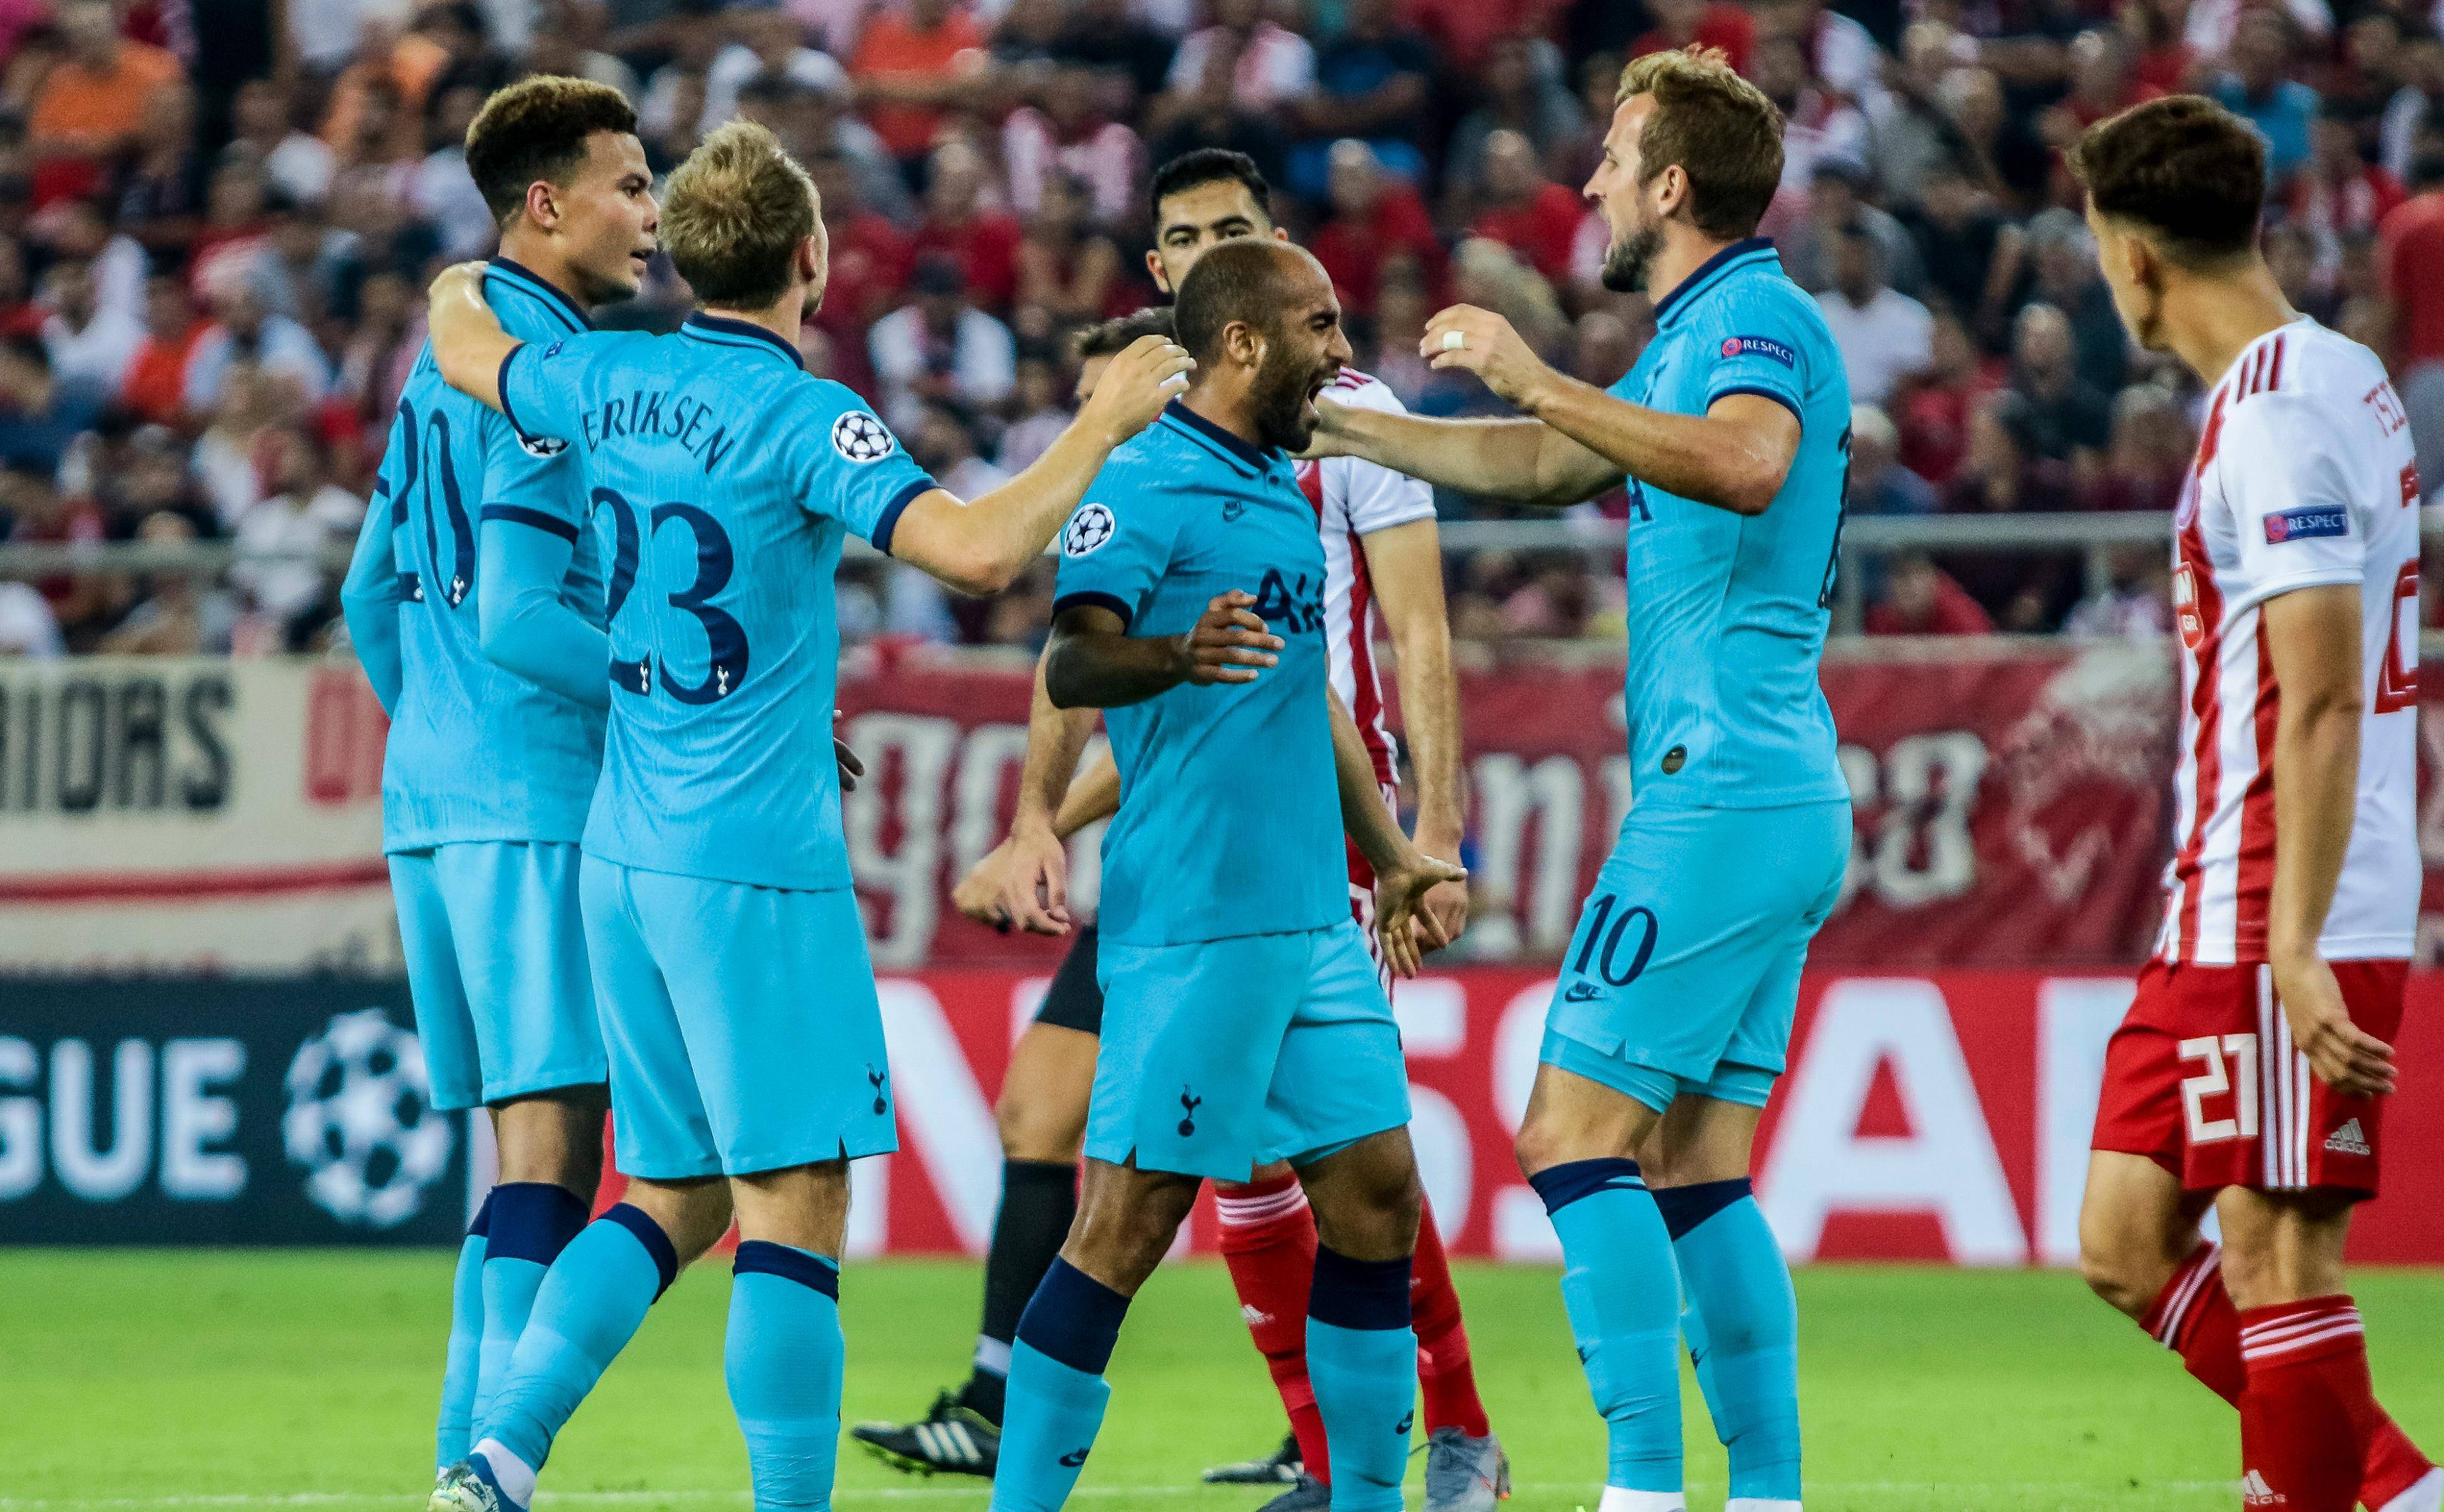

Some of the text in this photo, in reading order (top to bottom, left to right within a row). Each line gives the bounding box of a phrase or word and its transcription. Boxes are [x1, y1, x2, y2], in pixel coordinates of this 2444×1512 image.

[1743, 339, 1793, 362] RESPECT
[582, 390, 735, 475] ERIKSEN
[2288, 514, 2347, 532] RESPECT
[591, 486, 749, 705] 23
[1573, 893, 1659, 987] 10
[2180, 1033, 2259, 1144] 21
